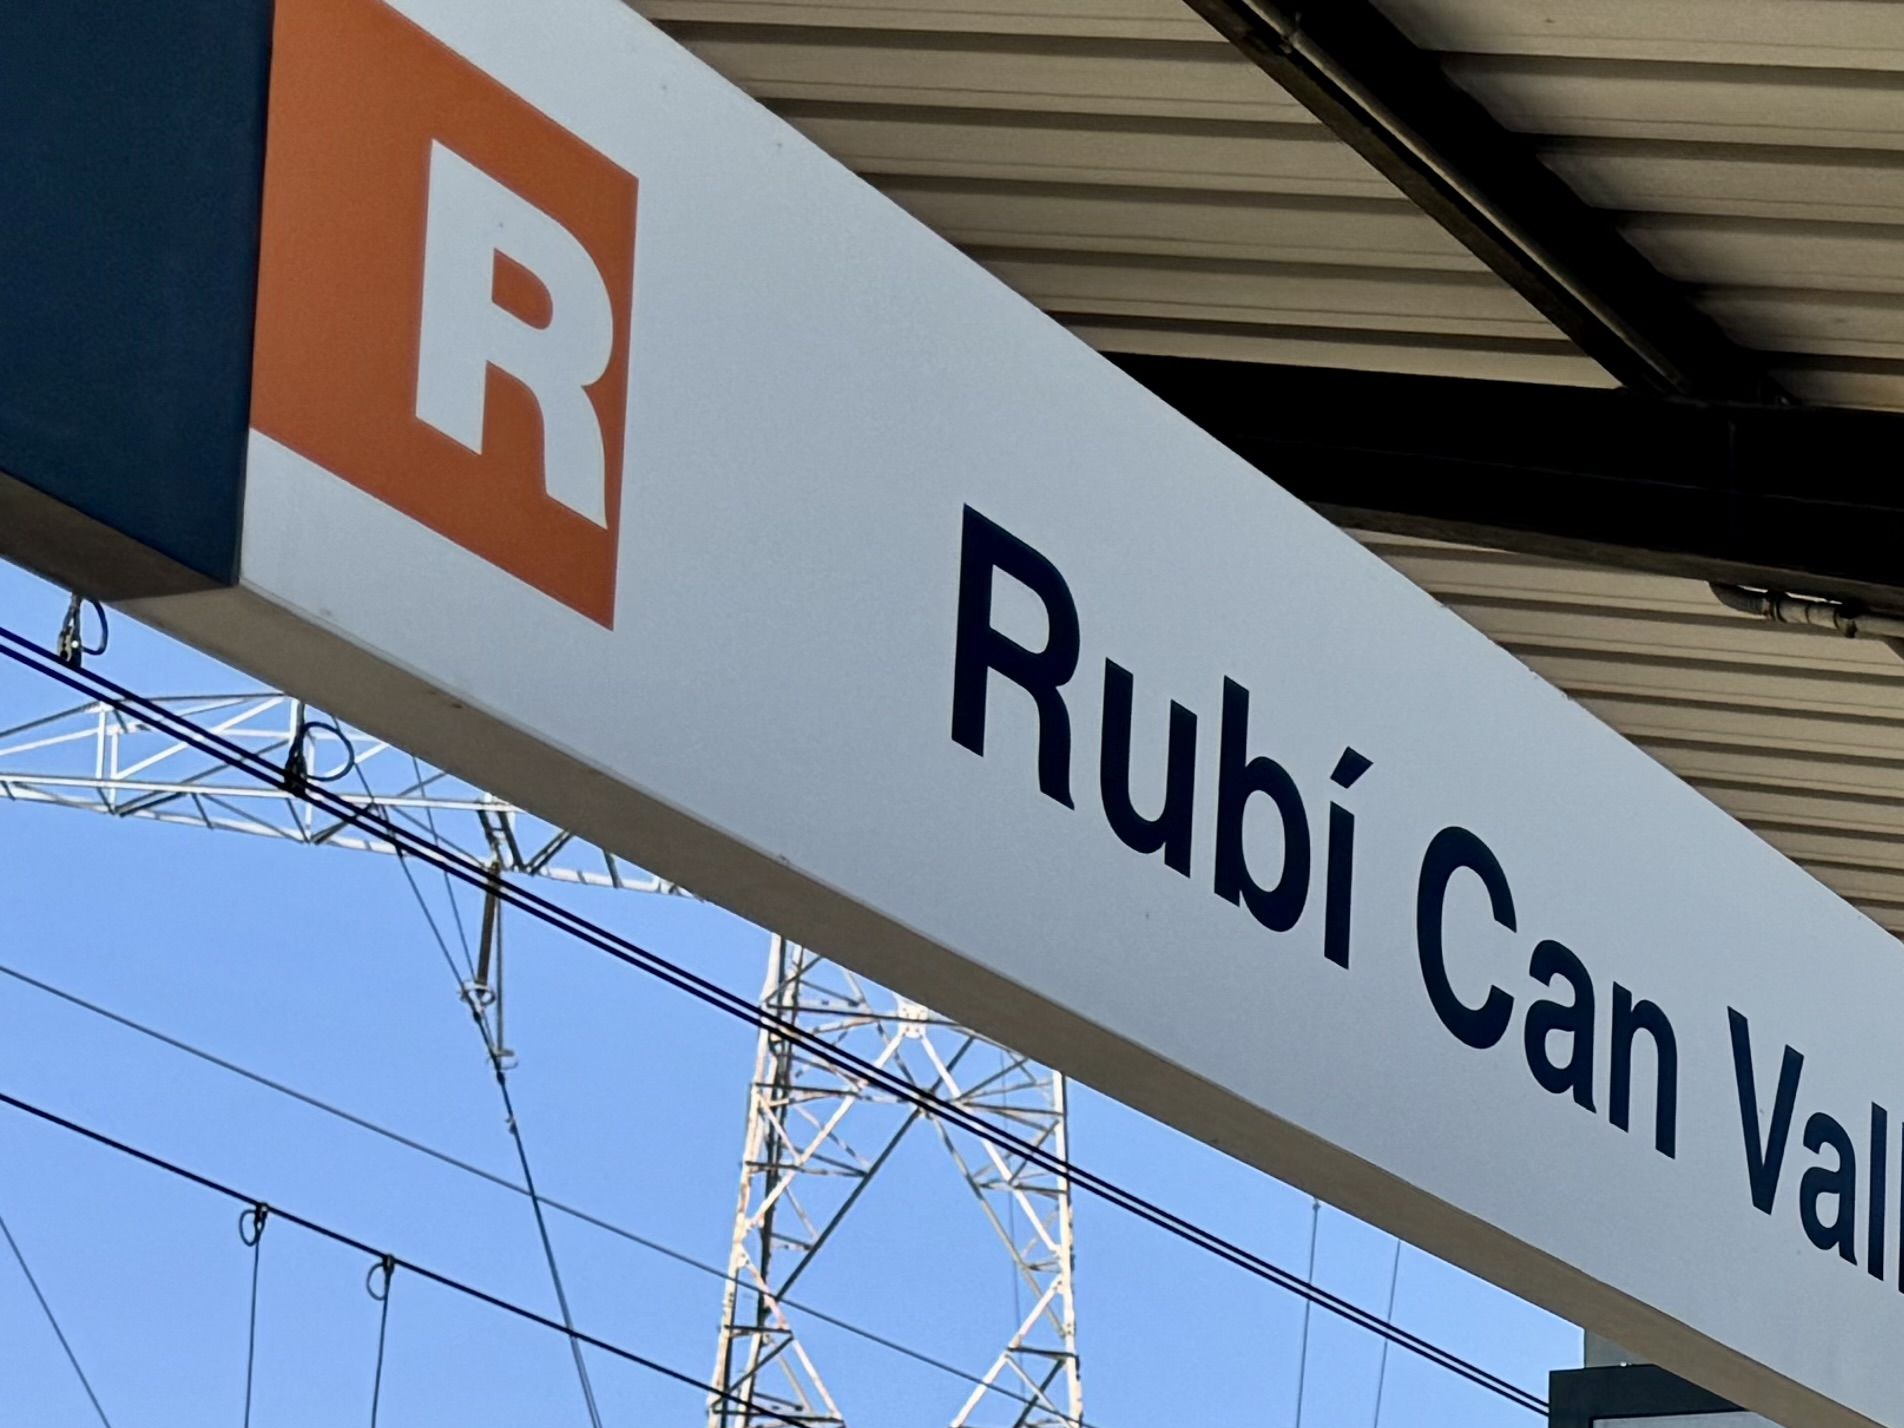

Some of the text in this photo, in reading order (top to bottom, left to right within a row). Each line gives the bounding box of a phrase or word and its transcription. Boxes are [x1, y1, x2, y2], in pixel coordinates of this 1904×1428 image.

[415, 138, 614, 529] R
[951, 503, 1374, 970] Rubí
[1416, 826, 1678, 1160] Can
